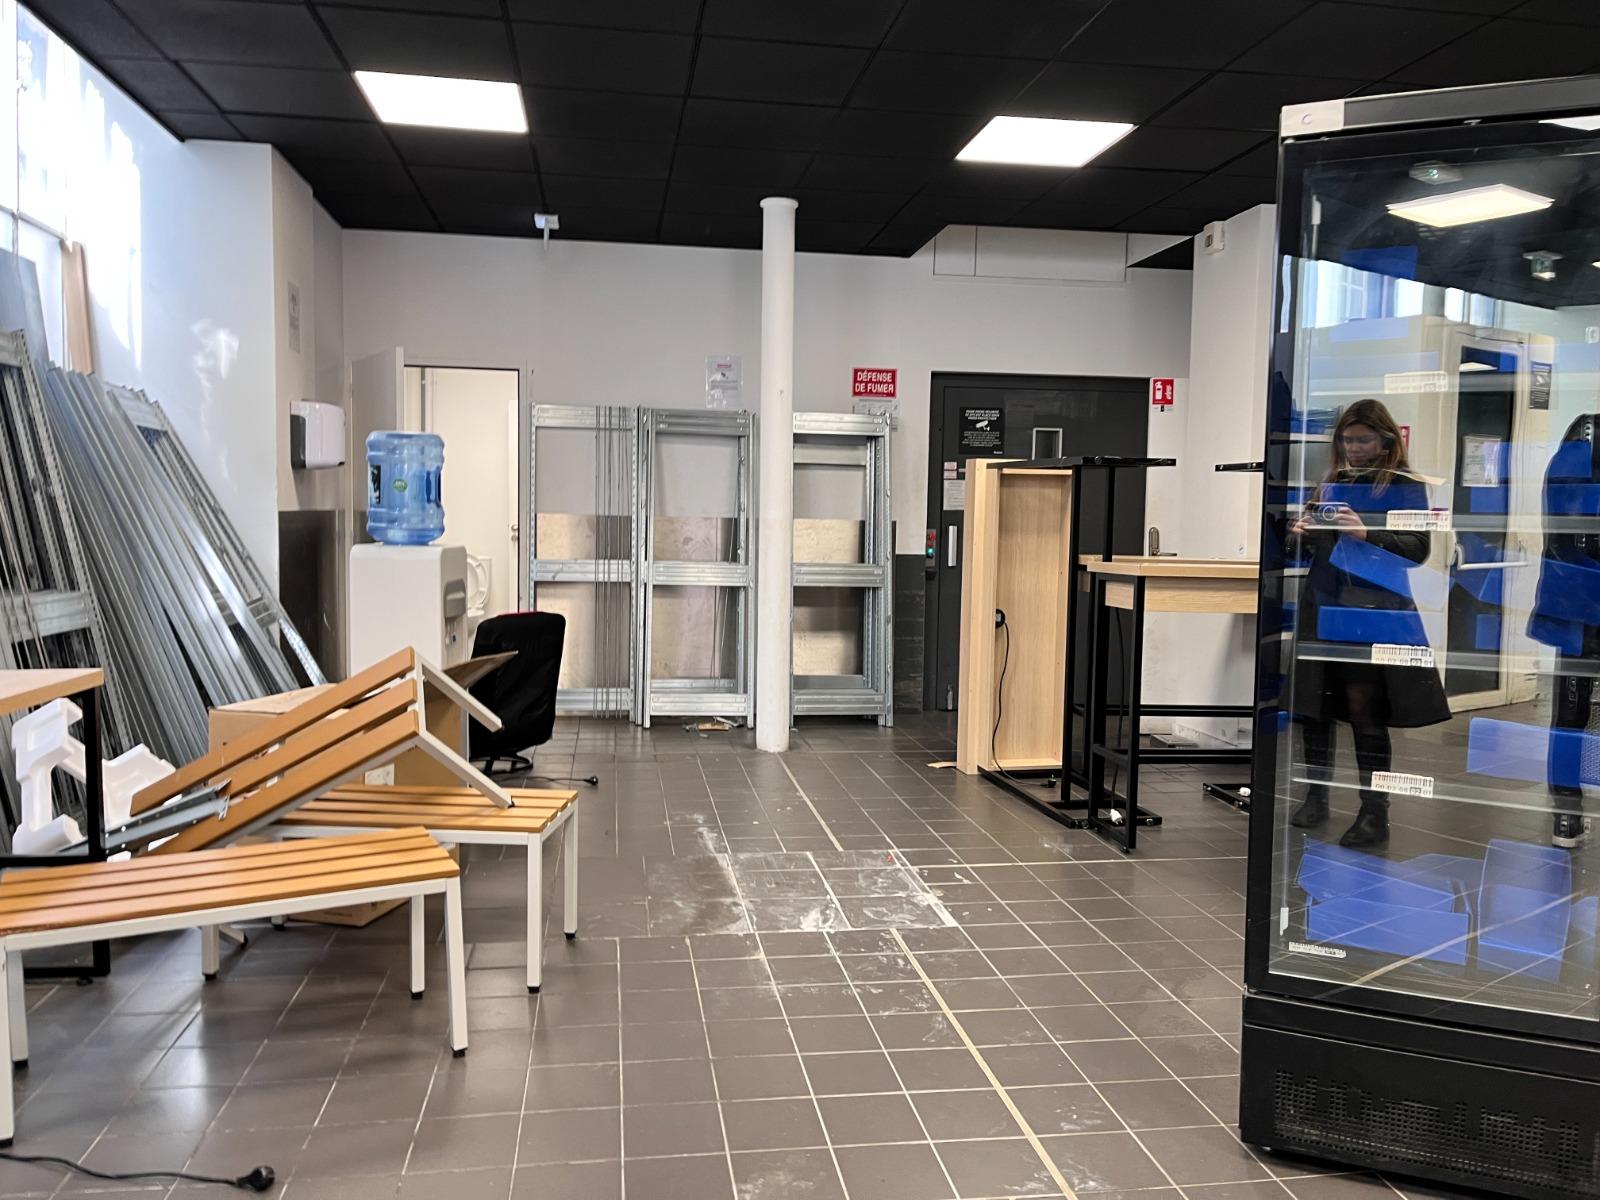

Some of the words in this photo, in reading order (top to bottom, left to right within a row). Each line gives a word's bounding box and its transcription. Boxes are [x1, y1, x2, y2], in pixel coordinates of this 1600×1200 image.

[857, 370, 892, 382] DÉFENSE
[855, 383, 865, 392] DE
[867, 383, 894, 393] FUMER
